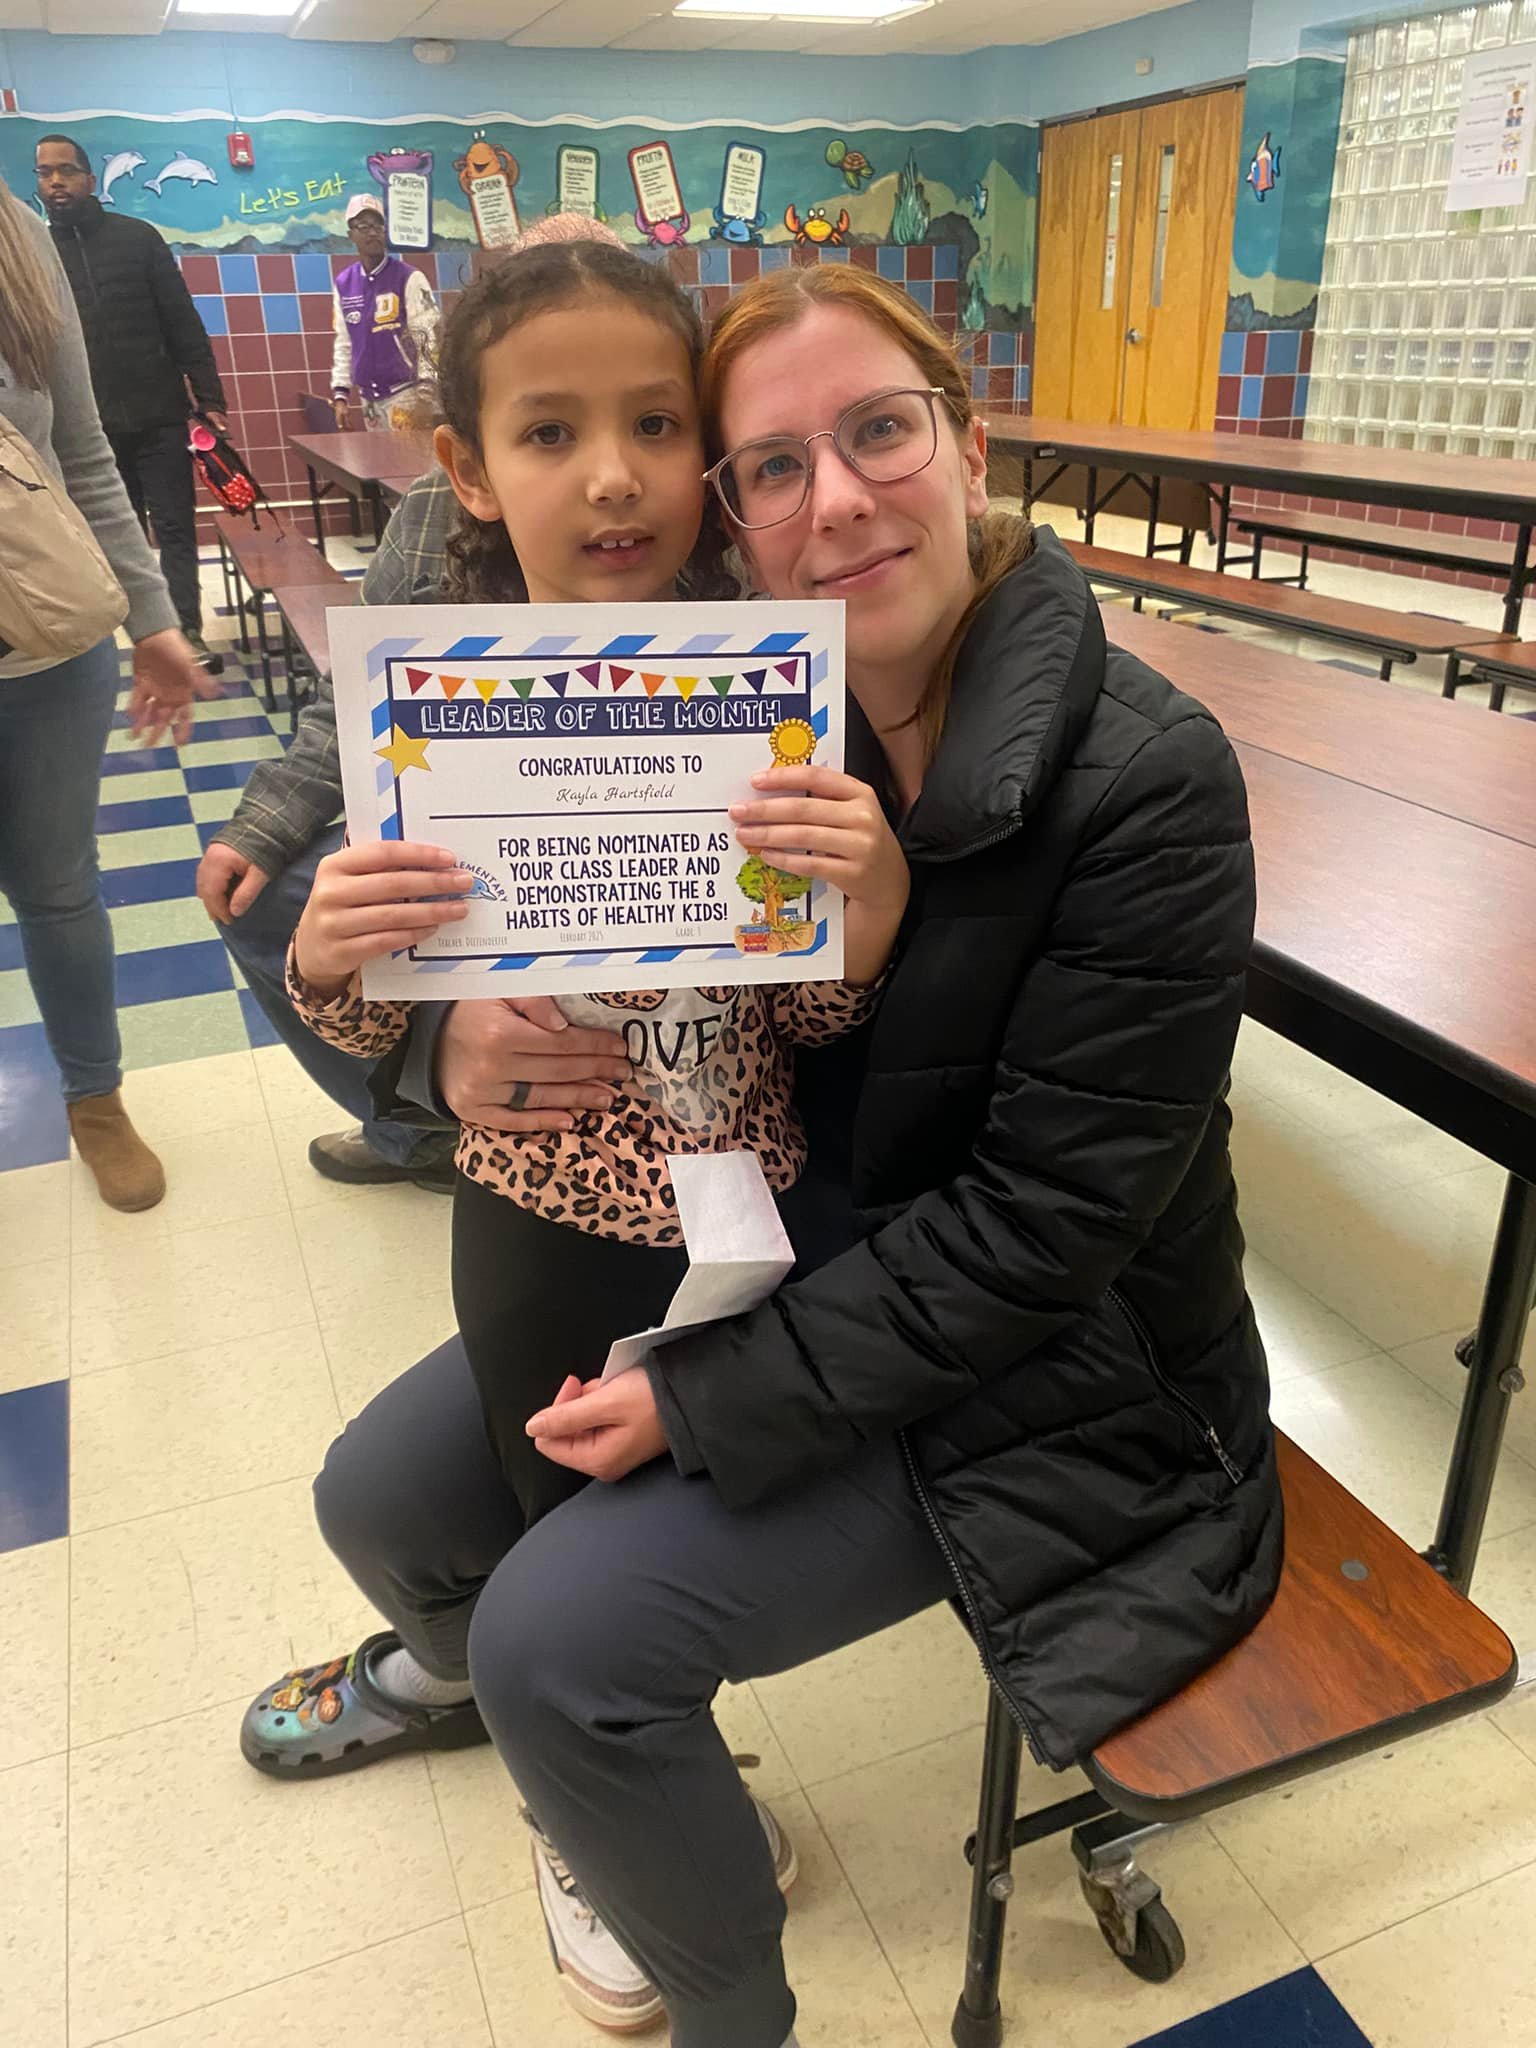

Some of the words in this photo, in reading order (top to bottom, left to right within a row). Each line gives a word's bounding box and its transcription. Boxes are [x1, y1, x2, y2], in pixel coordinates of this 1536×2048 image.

[240, 187, 300, 214] Let's
[304, 172, 348, 201] Eat
[421, 703, 546, 733] LEADER
[555, 703, 596, 730] OF
[606, 702, 665, 729] THE
[674, 700, 781, 728] MONTH
[519, 755, 675, 777] CONGRATULATIONS
[682, 755, 703, 773] TO
[555, 786, 599, 806] Kayla
[604, 784, 675, 802] Hartsfield
[498, 838, 530, 858] FOR
[537, 836, 591, 857] BEING
[598, 834, 700, 855] NOMINATED
[707, 833, 729, 852] AS
[453, 861, 509, 902] LEMENTARY
[510, 862, 553, 881] YOUR
[560, 859, 613, 880] CLASS
[619, 858, 679, 878] LEADER
[685, 857, 721, 875] AND
[517, 881, 662, 905] DEMONSTRATING
[668, 880, 699, 899] THE
[706, 880, 716, 898] 8
[506, 909, 570, 930] HABITS
[577, 907, 598, 926] OF
[604, 904, 676, 925] HEALTHY
[682, 902, 728, 922] KIDS!
[560, 932, 586, 943] FEBRUARY
[622, 1014, 722, 1072] OVE
